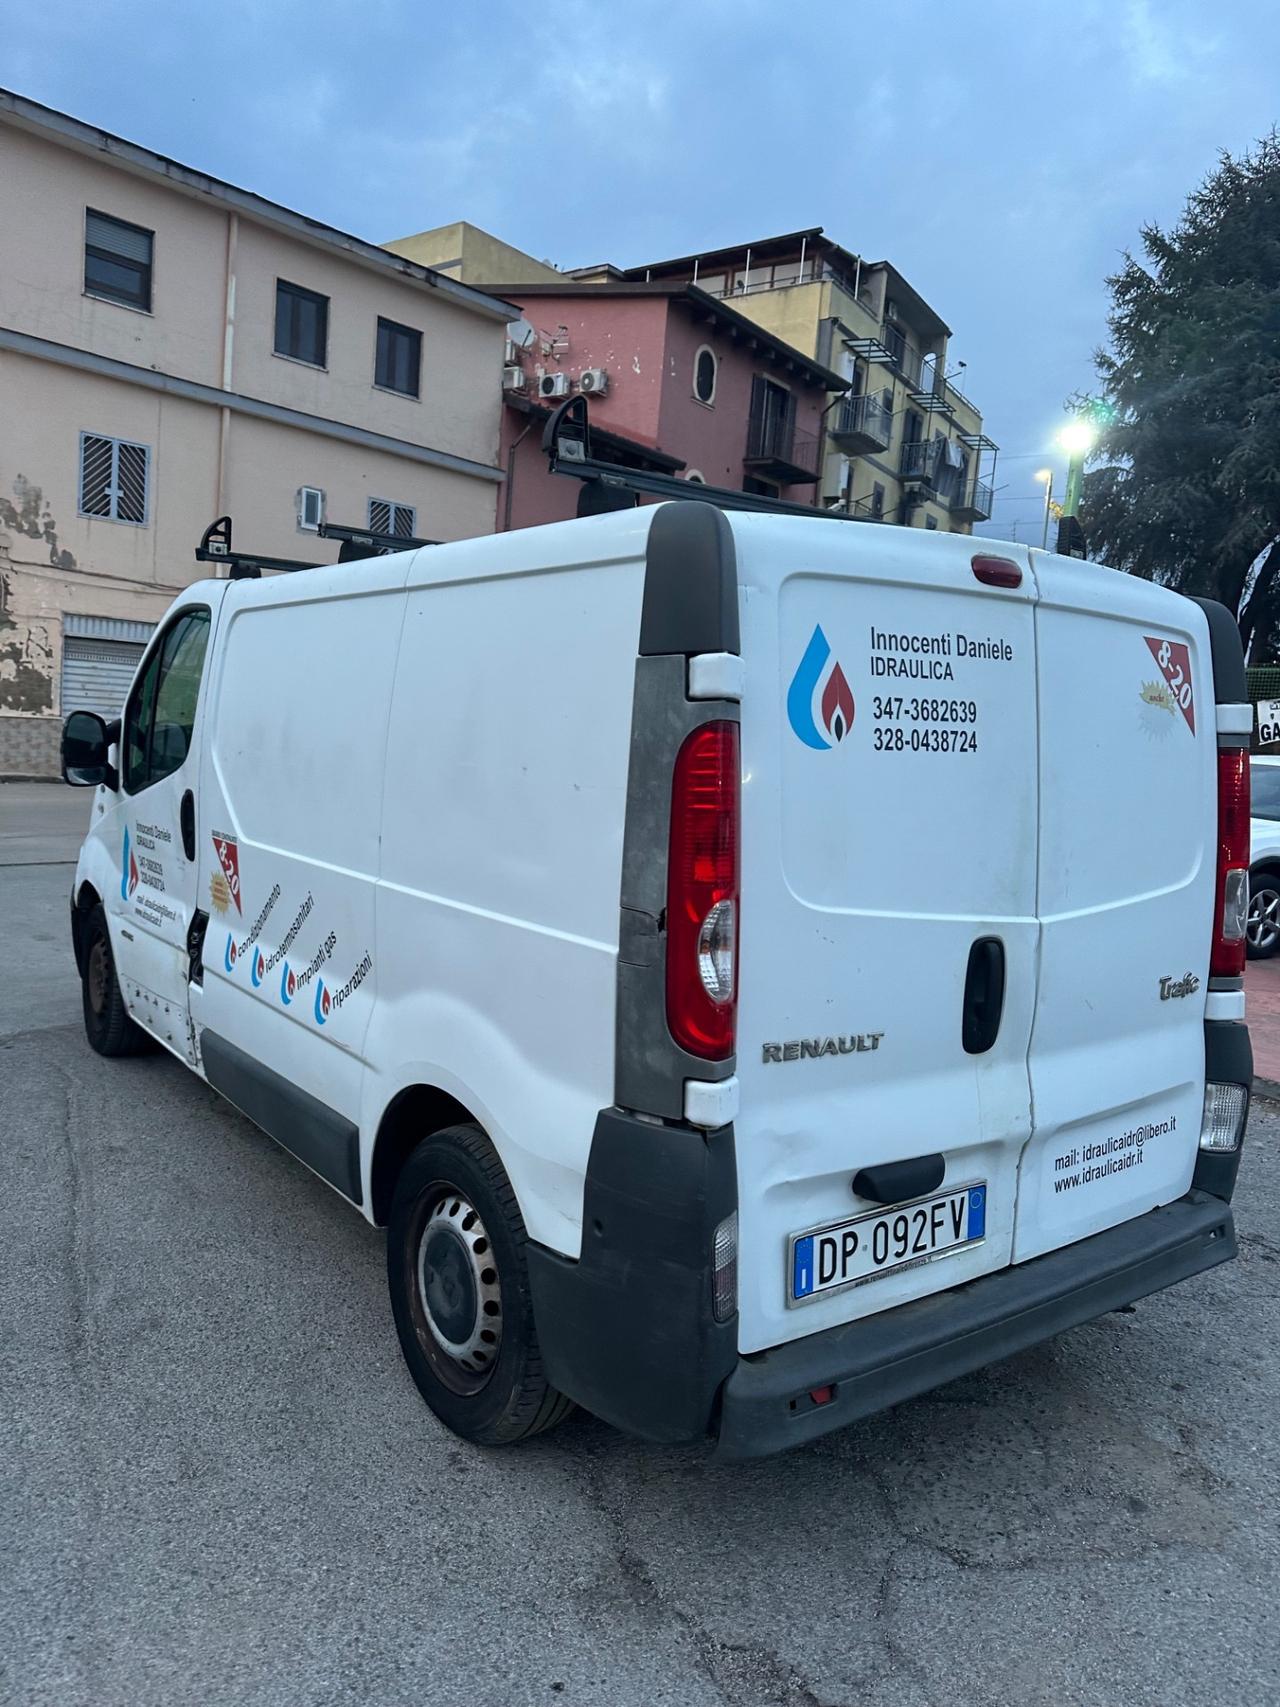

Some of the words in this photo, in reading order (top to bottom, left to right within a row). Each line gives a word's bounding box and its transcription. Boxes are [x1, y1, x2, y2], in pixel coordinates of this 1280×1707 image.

[870, 626, 951, 656] Innocenti
[956, 633, 1013, 662] Daniele
[870, 656, 954, 681] IDRAULICA
[1157, 640, 1192, 709] 8-20
[873, 696, 977, 723] 347-3682639
[874, 727, 978, 753] 328-0438724
[219, 841, 239, 895] 8-20
[296, 942, 326, 990] impianti
[325, 930, 338, 959] gas
[332, 950, 373, 1010] riparazioni
[1159, 970, 1200, 1001] Trafic
[762, 1031, 884, 1064] RENAULT
[1055, 1148, 1080, 1172] mail:
[1082, 1115, 1177, 1162] idraulicaidr@libero.it
[1054, 1148, 1144, 1193] www.idraulicaidr.it
